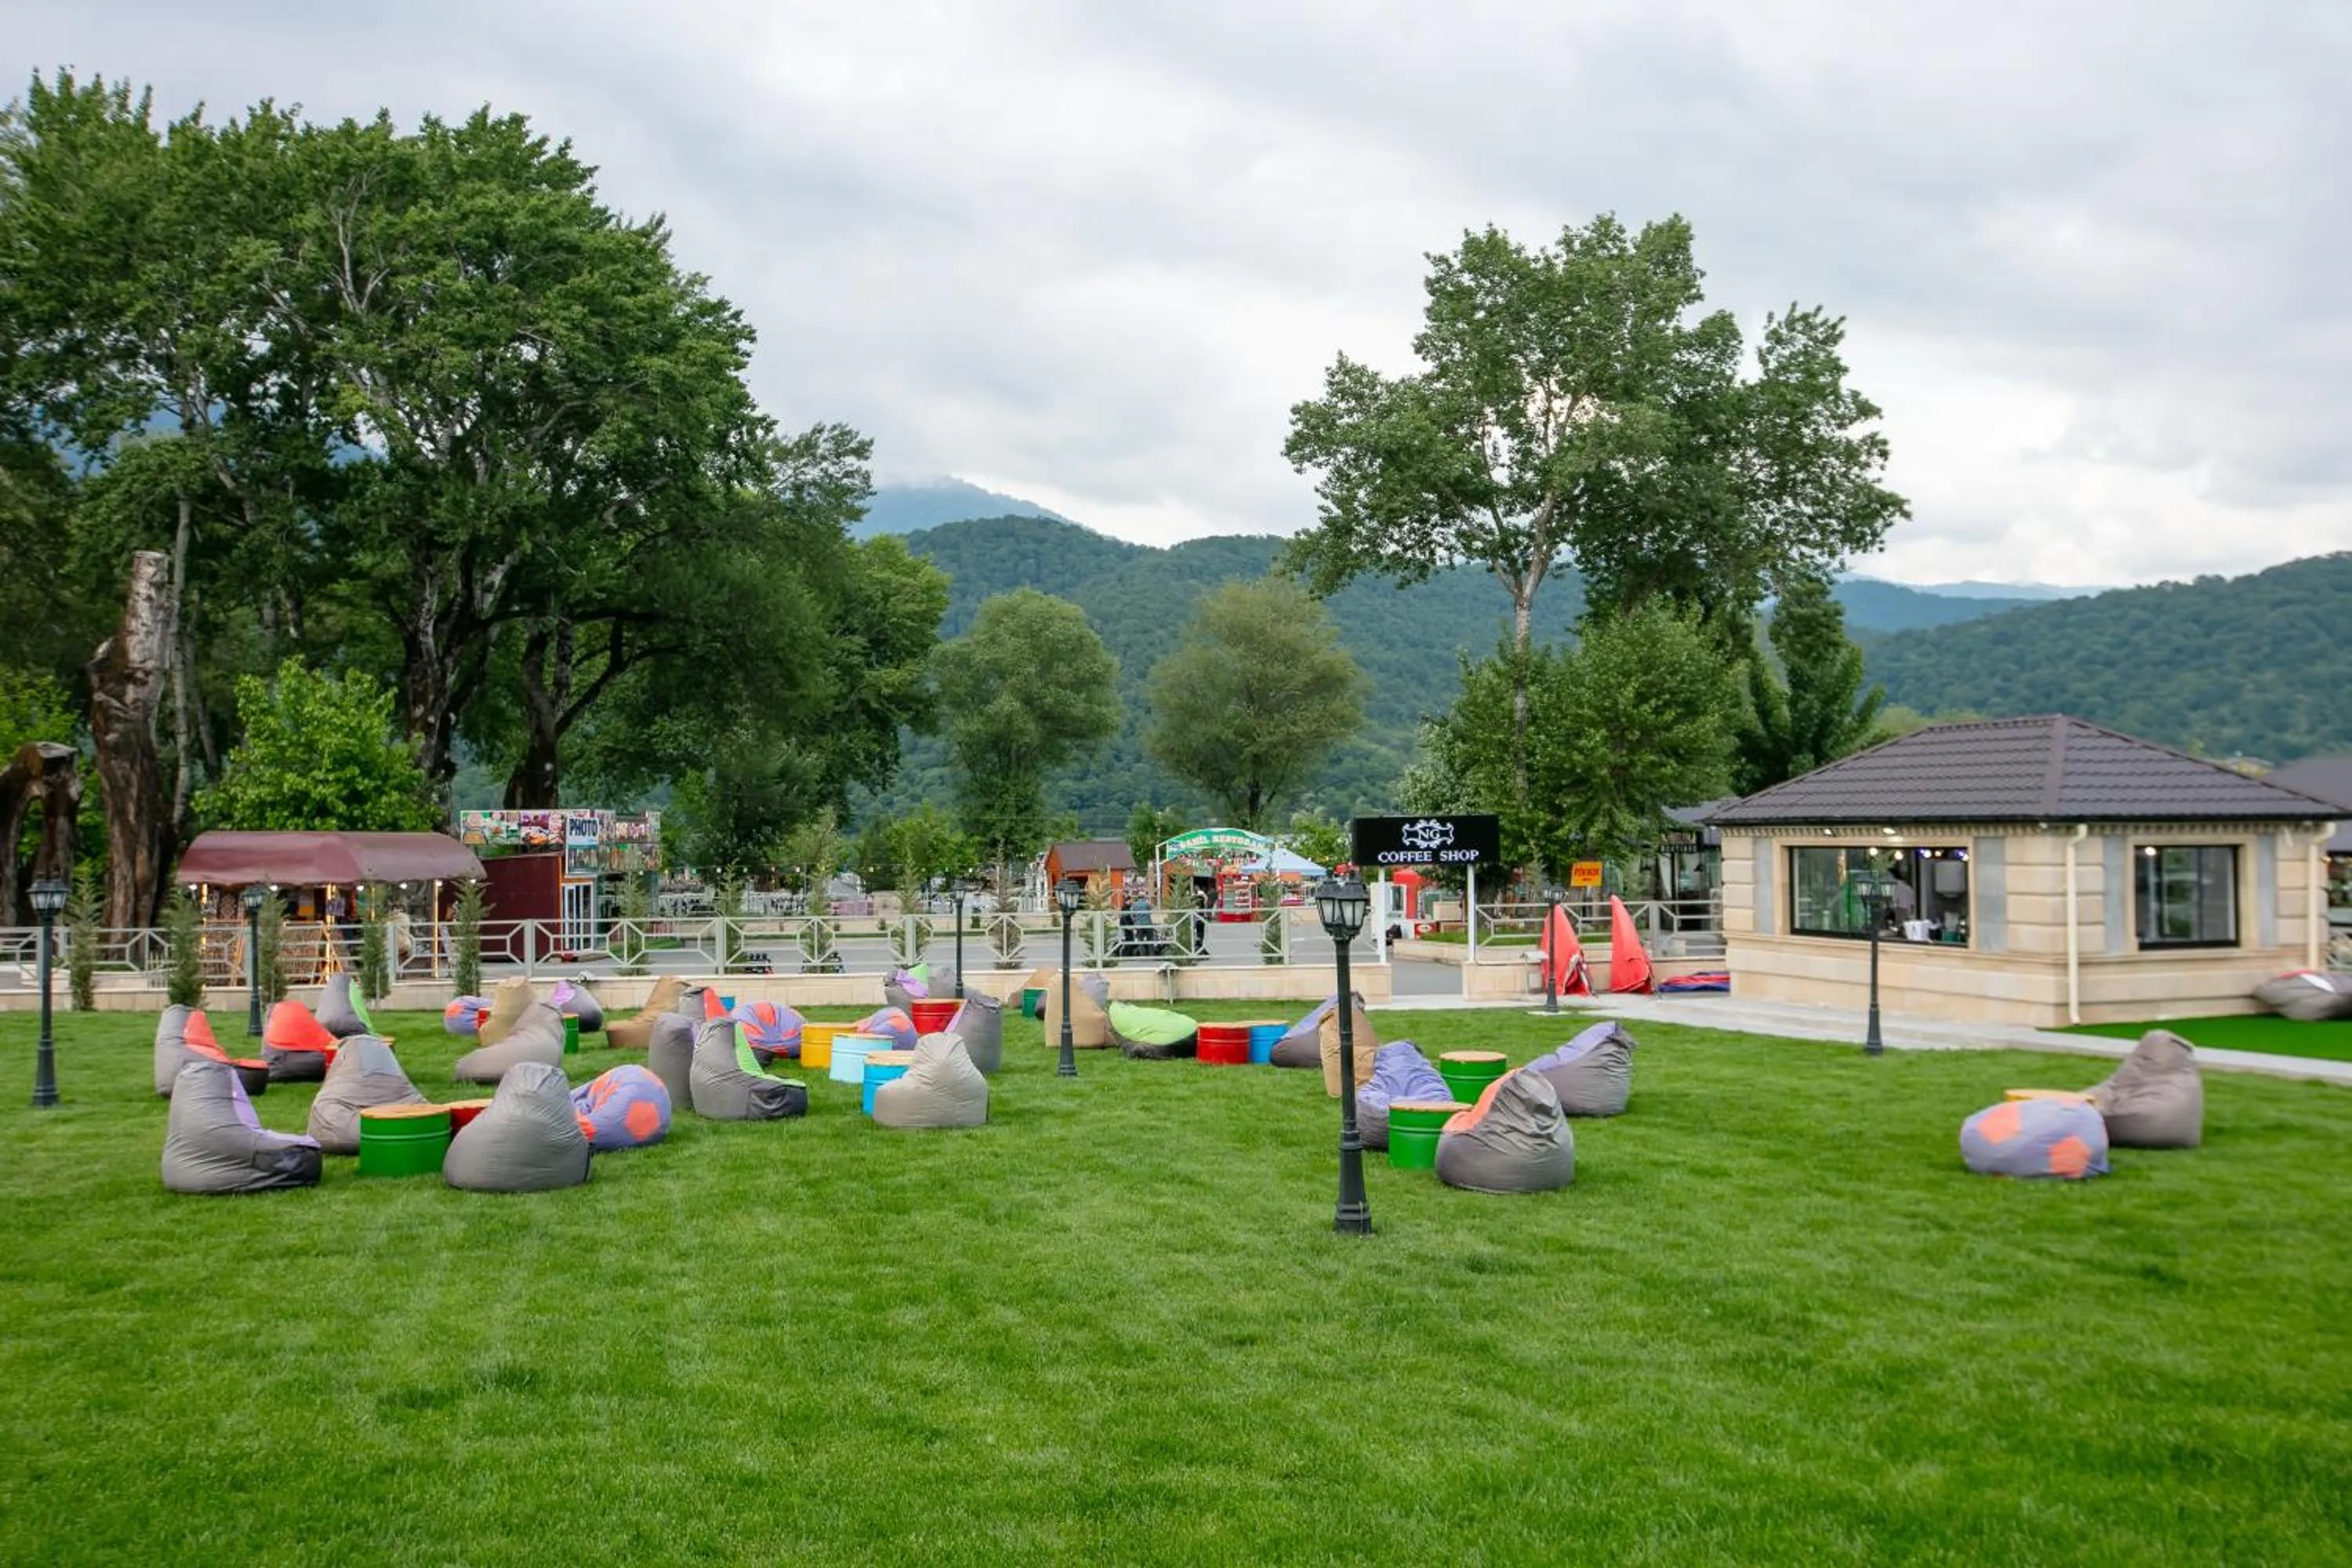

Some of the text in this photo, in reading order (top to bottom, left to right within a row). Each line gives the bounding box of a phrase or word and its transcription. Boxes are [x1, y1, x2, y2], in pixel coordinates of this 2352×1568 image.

[568, 818, 598, 837] PHOTO
[1417, 828, 1440, 840] NG
[1377, 849, 1479, 862] COFFEE SHOP
